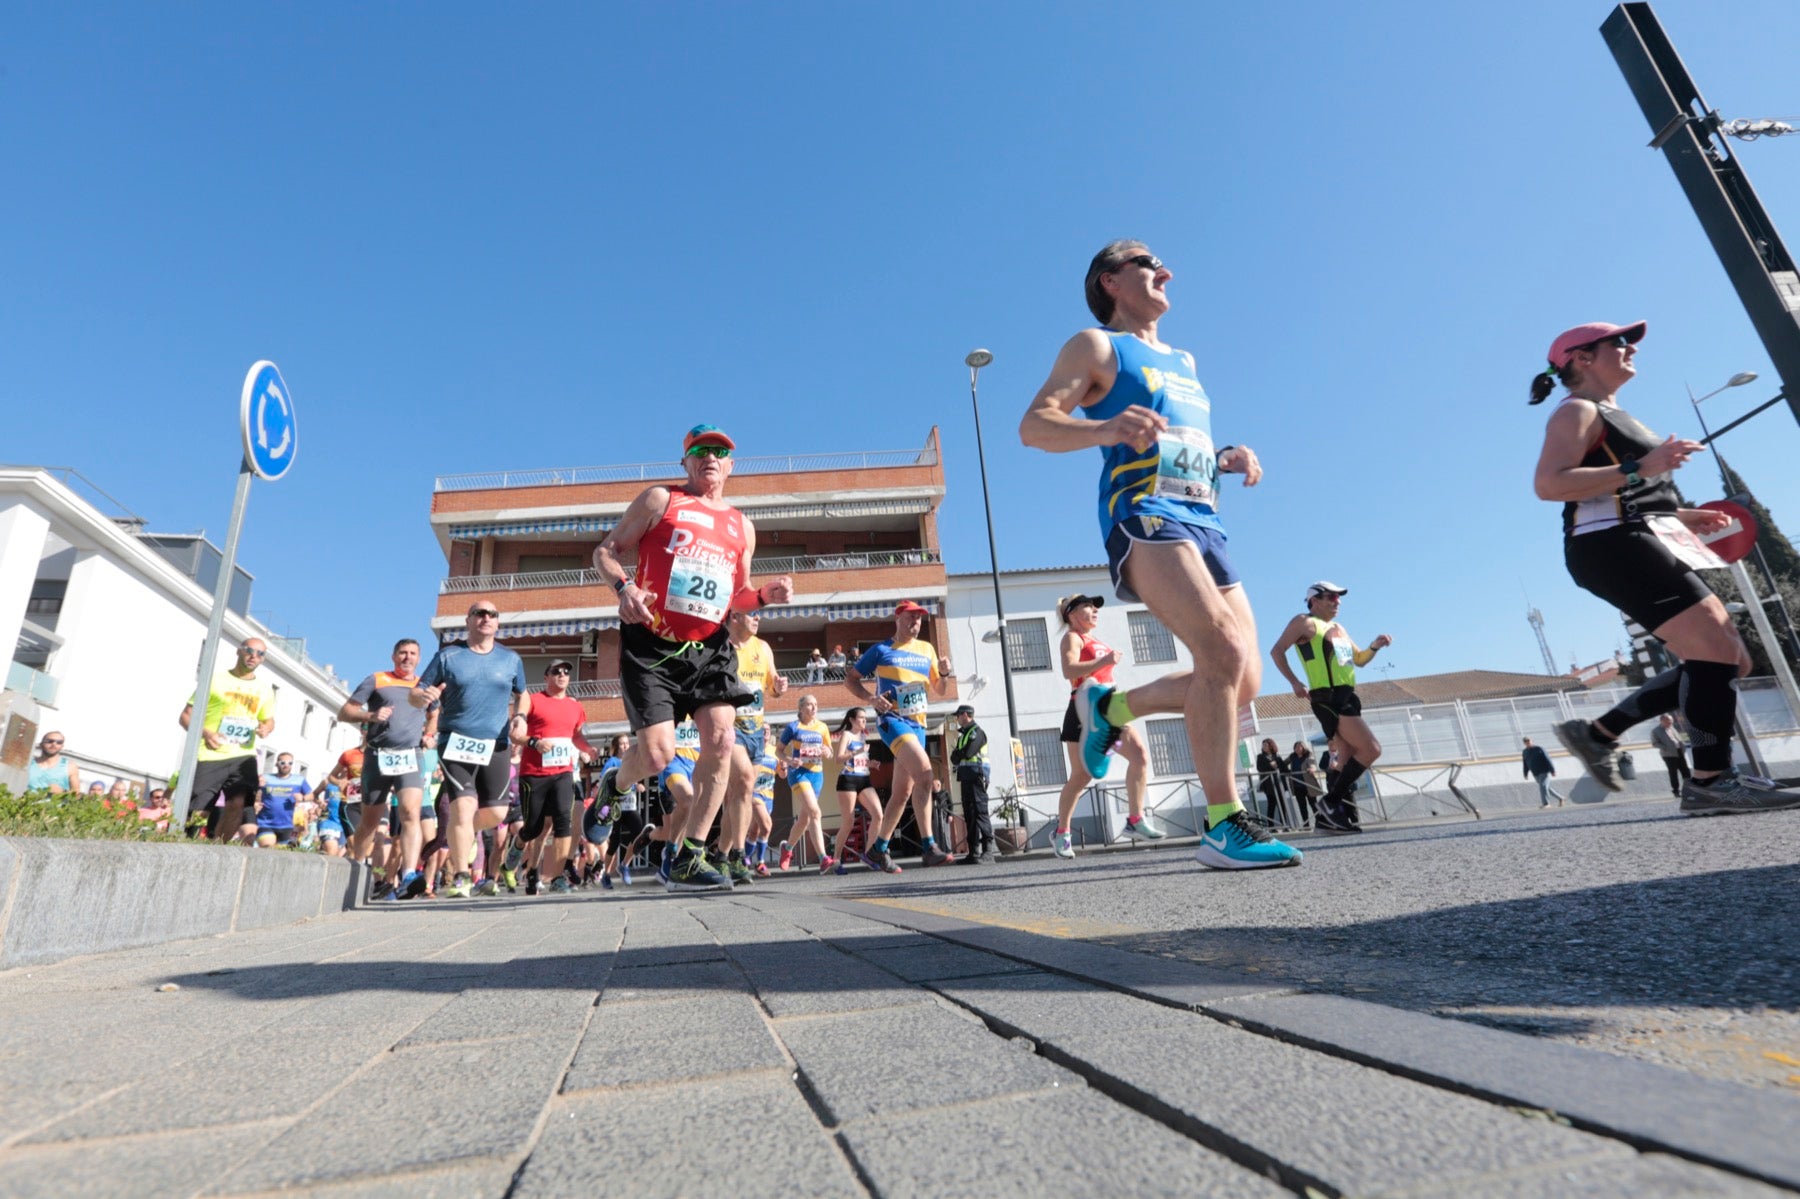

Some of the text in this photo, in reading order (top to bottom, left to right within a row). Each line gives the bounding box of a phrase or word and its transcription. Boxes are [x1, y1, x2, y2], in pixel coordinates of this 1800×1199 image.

[687, 576, 717, 601] 28
[903, 692, 923, 705] 484
[455, 738, 487, 754] 329
[385, 754, 410, 766] 321
